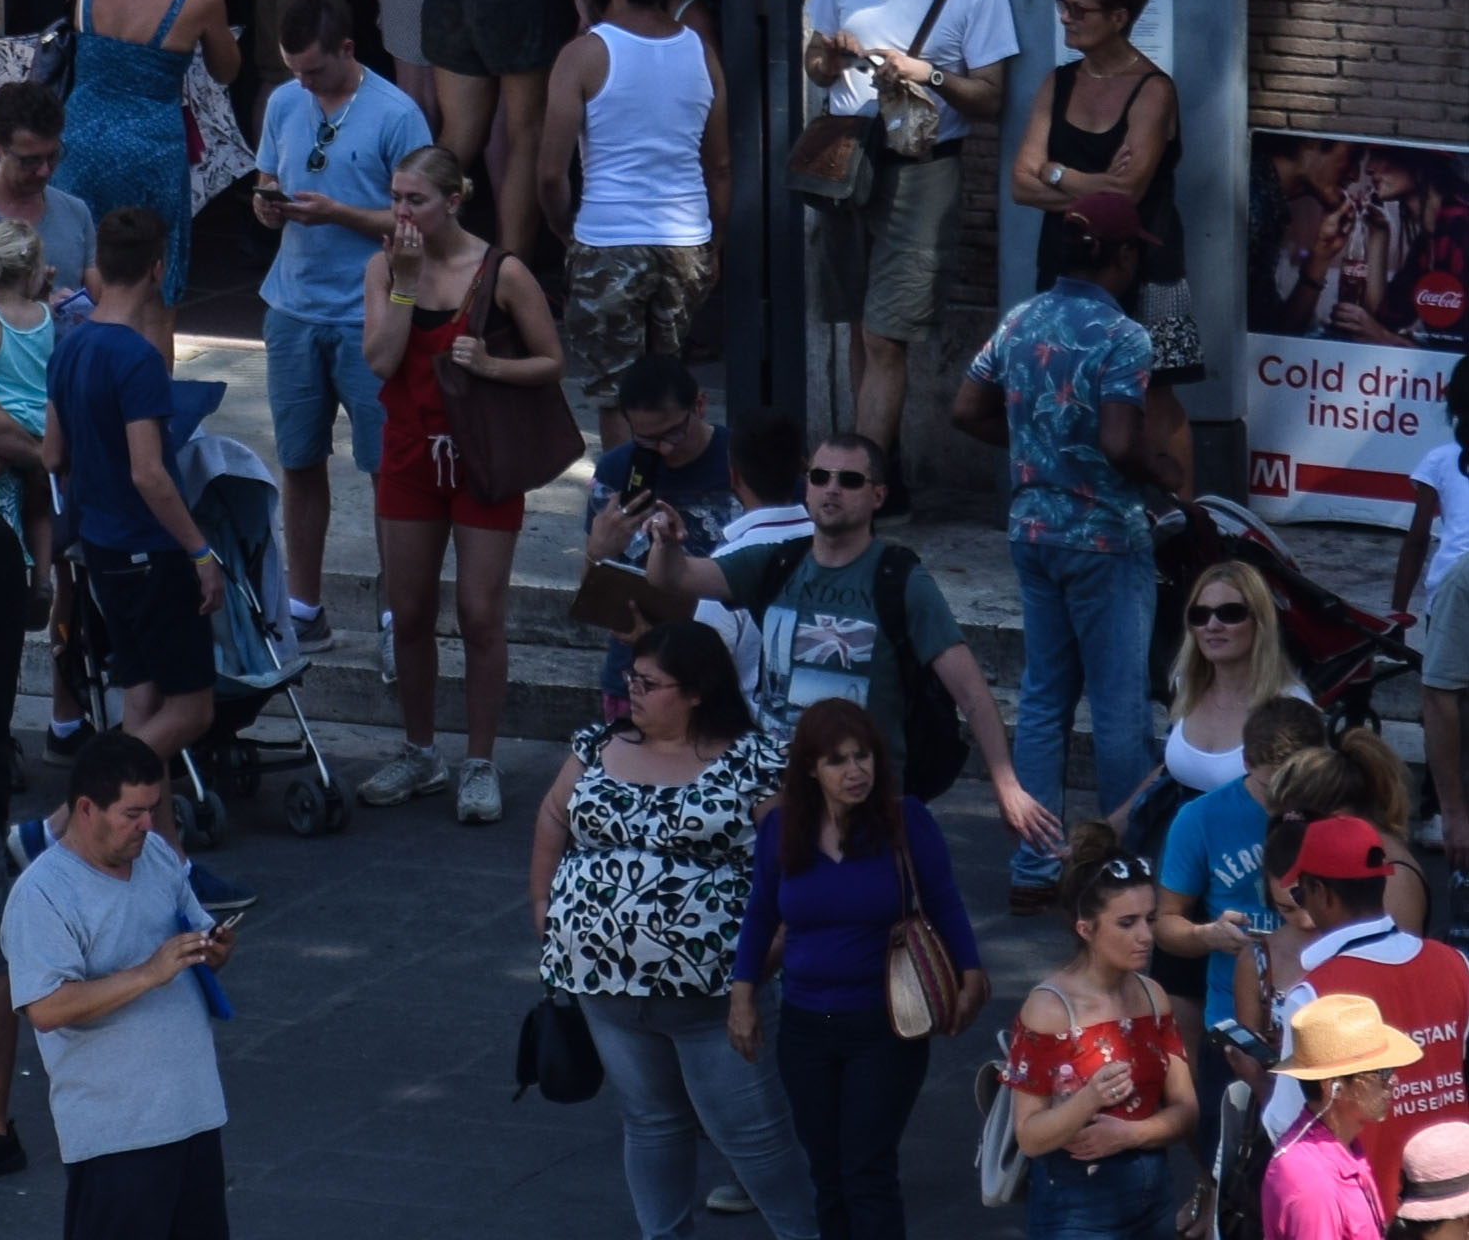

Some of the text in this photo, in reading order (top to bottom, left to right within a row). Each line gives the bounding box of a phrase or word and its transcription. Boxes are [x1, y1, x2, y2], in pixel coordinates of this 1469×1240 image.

[1257, 355, 1344, 393] Cold
[1307, 396, 1419, 436] inside
[1251, 458, 1287, 489] M
[783, 579, 874, 609] ONDON
[1392, 1071, 1464, 1101] OPEN BUS
